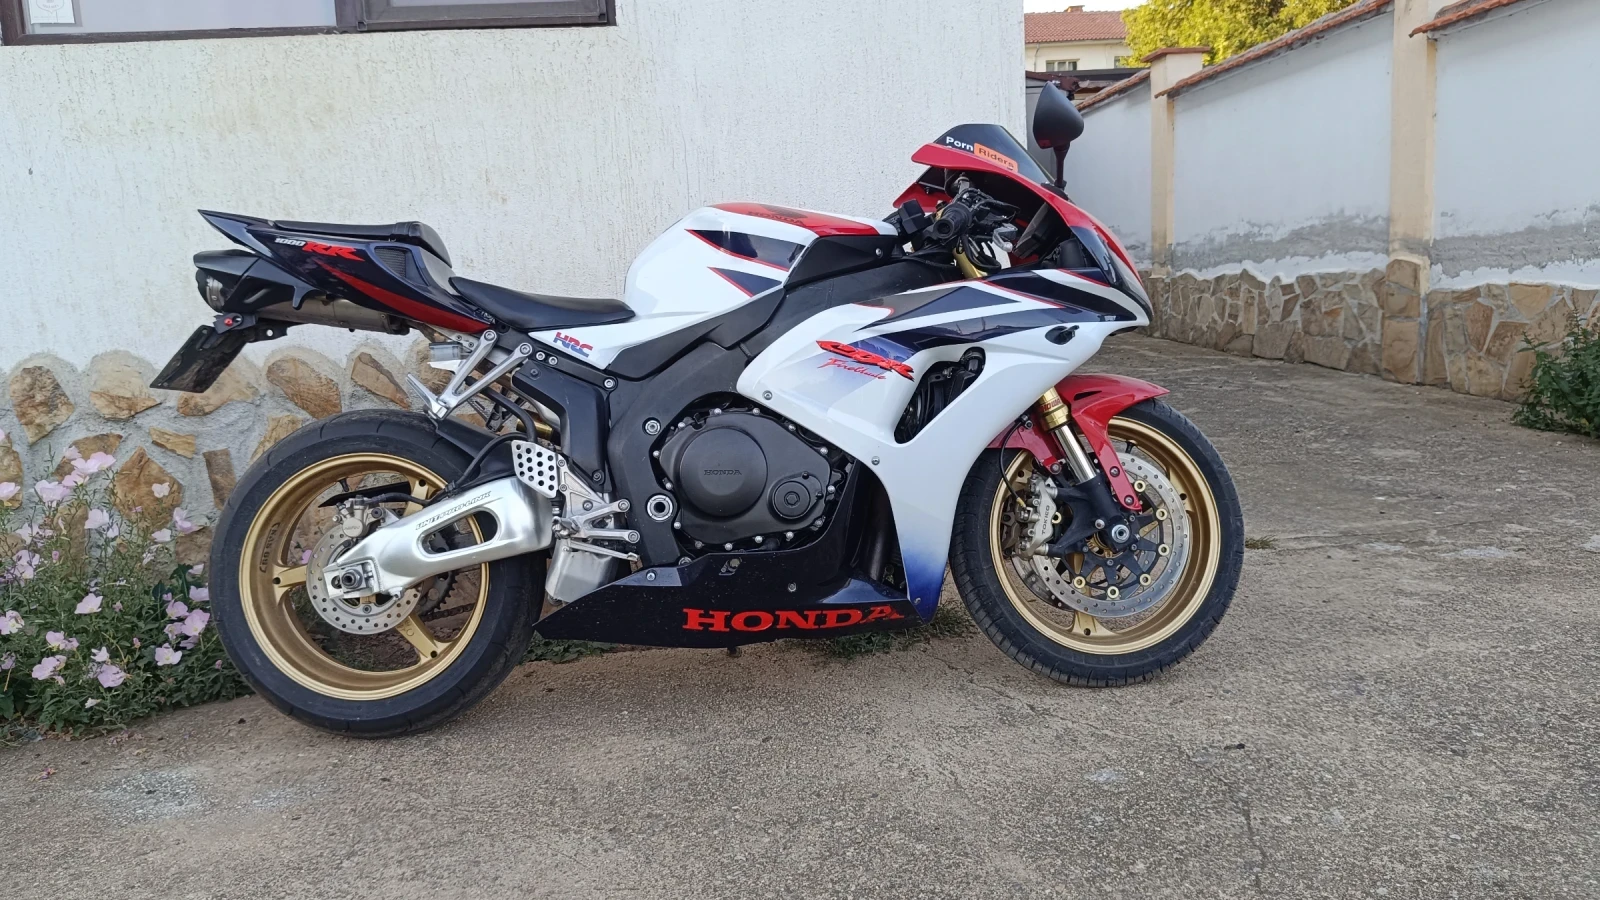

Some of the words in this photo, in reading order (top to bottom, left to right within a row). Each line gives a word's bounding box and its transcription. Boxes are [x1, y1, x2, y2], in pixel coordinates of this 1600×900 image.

[945, 136, 974, 152] Porn
[978, 147, 1015, 170] Riders
[274, 237, 306, 247] 1000
[302, 240, 365, 262] RR
[552, 331, 594, 358] HRC
[816, 340, 915, 382] CBR
[682, 604, 905, 632] HONDA
